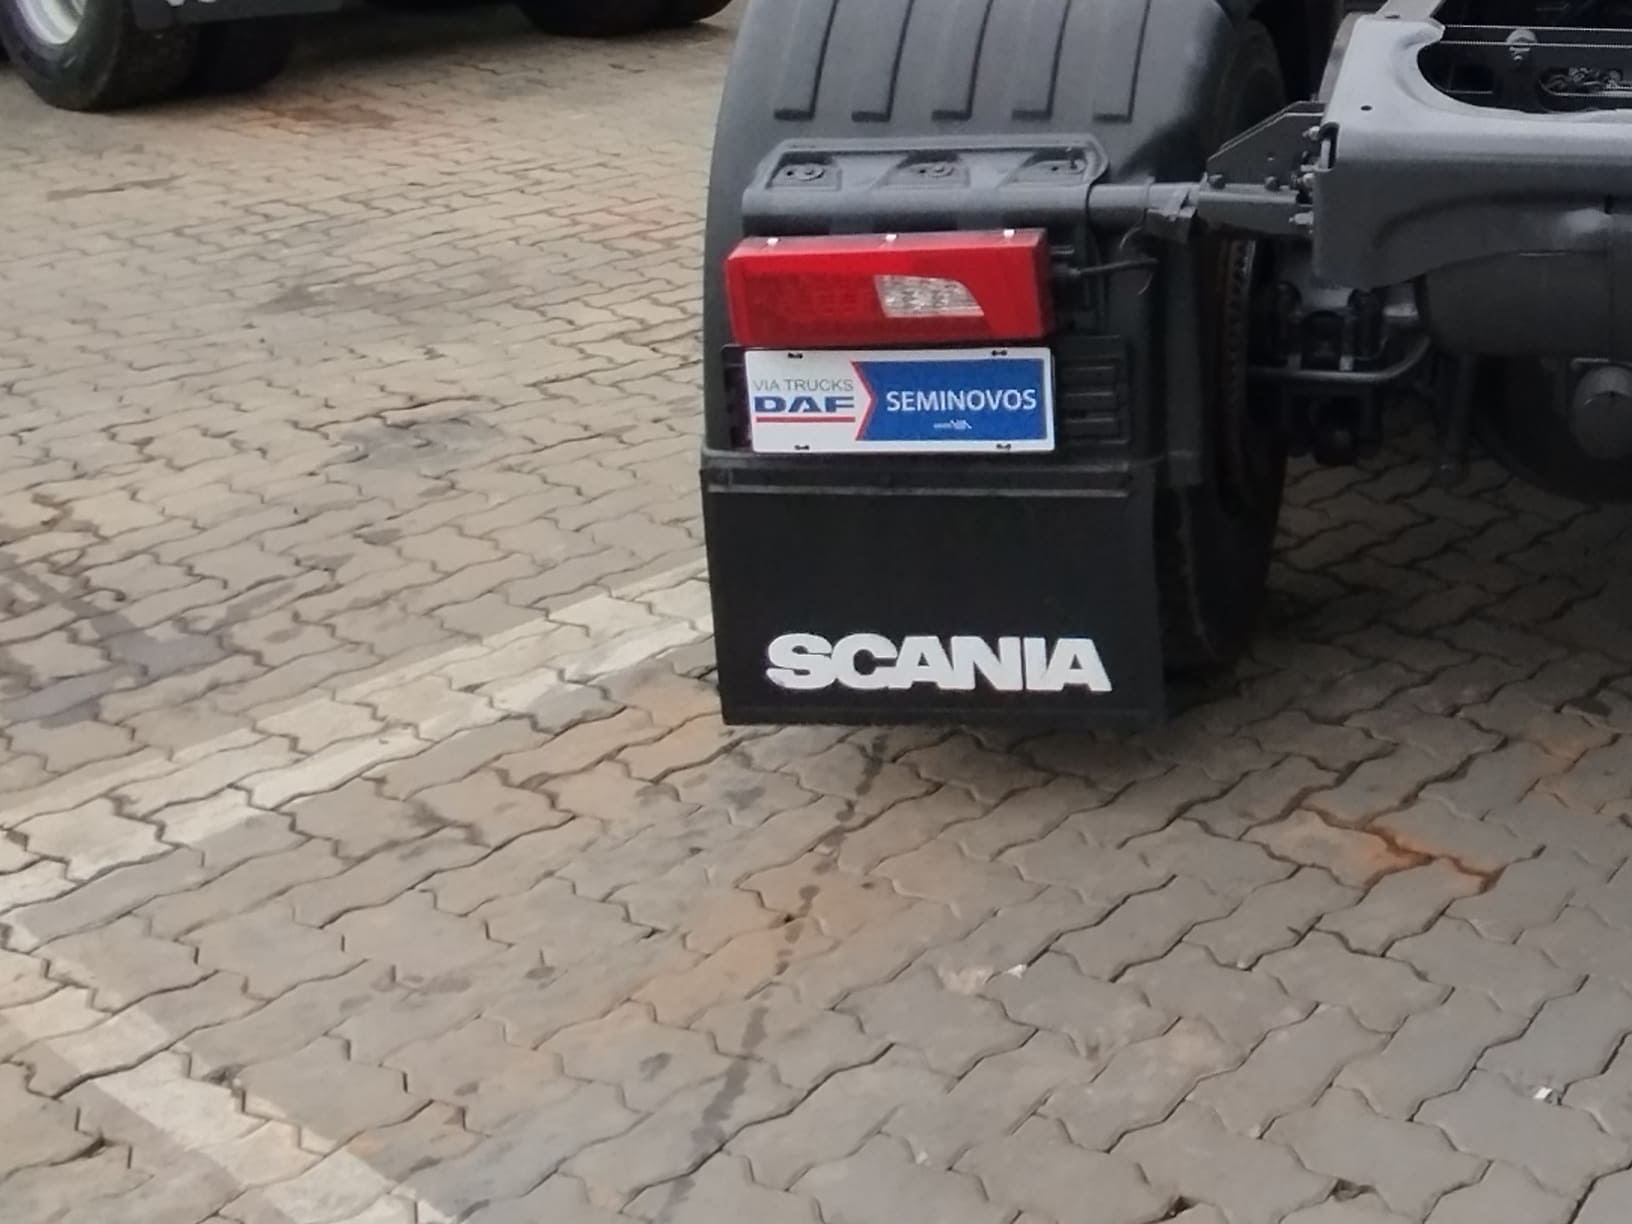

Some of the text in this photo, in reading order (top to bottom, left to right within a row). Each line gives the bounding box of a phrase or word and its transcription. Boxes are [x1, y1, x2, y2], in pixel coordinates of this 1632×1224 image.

[753, 378, 855, 392] VIA TRUCKS
[754, 396, 855, 413] DAF
[886, 389, 1037, 412] SEMINOVOS
[766, 632, 1112, 692] SCANIA
